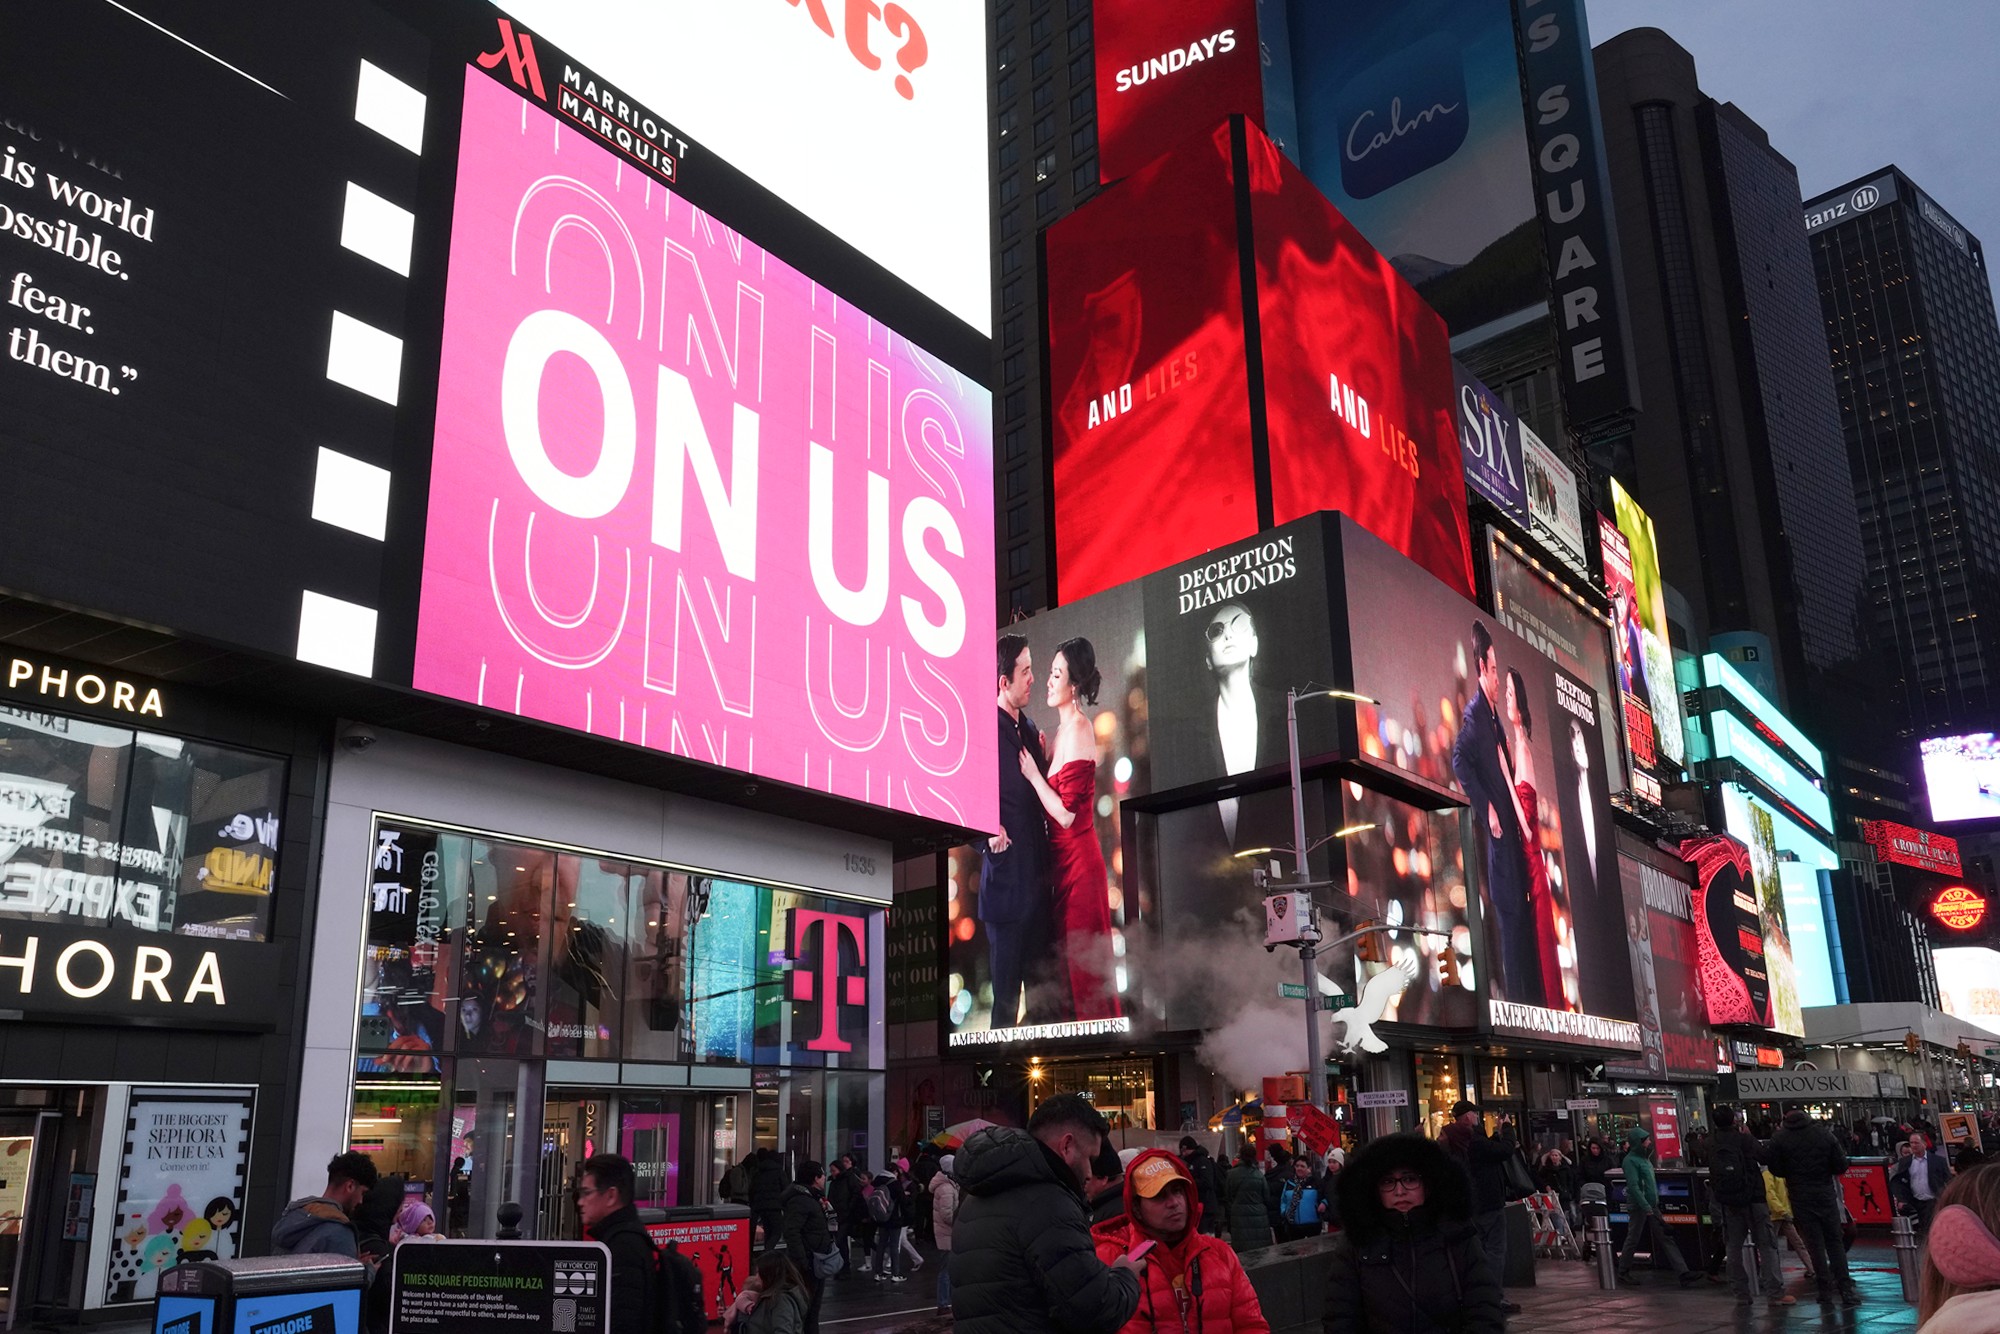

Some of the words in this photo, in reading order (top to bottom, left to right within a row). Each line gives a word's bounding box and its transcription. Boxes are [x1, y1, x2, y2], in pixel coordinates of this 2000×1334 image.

[1116, 29, 1236, 92] SUNDAYS
[563, 65, 689, 159] MARRIOTT
[561, 92, 675, 177] MARQUIS
[1346, 97, 1459, 162] Calm
[47, 173, 155, 243] world
[1923, 202, 1953, 238] Allianz
[1537, 84, 1606, 384] SQUARE
[8, 272, 95, 334] fear.
[1088, 382, 1132, 430] AND
[1145, 351, 1198, 402] LIES
[1329, 372, 1371, 439] AND
[1378, 413, 1420, 479] LIES
[1461, 385, 1520, 492] SIX
[502, 309, 760, 583] ON
[808, 440, 967, 658] US
[1178, 535, 1294, 593] DECEPTION
[1178, 557, 1297, 615] DIAMONDS
[8, 658, 164, 718] PHORA
[1554, 672, 1593, 710] DECEPTION
[1556, 689, 1596, 727] DIAMONDS
[843, 852, 876, 877] 1535
[1945, 891, 1969, 902] HOT
[1949, 915, 1975, 925] NOW
[1284, 984, 1307, 998] Broadway
[1325, 997, 1333, 1008] W
[1335, 997, 1346, 1007] 46
[952, 1029, 1009, 1047] AMERICAN
[1012, 1025, 1048, 1041] EAGLE
[1050, 1019, 1126, 1038] OUTFITTERS
[1496, 1002, 1554, 1033] AMERICAN
[1557, 1012, 1587, 1037] EAGLE
[1738, 1075, 1848, 1093] SWAROVSKI
[148, 1128, 226, 1143] SEPHORA
[152, 1114, 176, 1125] THE
[178, 1114, 228, 1126] BIGGEST
[586, 1103, 595, 1137] NYC
[147, 1146, 163, 1159] IN
[165, 1146, 194, 1159] THE
[197, 1146, 224, 1159] USA
[160, 1163, 184, 1172] Come
[654, 1228, 672, 1236] MOST
[673, 1227, 688, 1236] TONY
[689, 1224, 738, 1236] AWARD-WINNING
[403, 1273, 427, 1285] TIMES
[428, 1274, 461, 1286] SQUARE
[462, 1275, 514, 1288] PEDESTRIAN
[515, 1276, 543, 1289] PLAZA
[441, 1292, 469, 1300] Crossroads
[554, 1271, 596, 1295] DOT
[409, 1308, 434, 1316] courteous
[444, 1309, 471, 1318] respectful
[477, 1311, 496, 1319] others,
[508, 1312, 525, 1321] please
[526, 1313, 540, 1321] keep
[410, 1316, 423, 1324] plaza
[480, 1302, 504, 1311] enjoyable
[505, 1303, 519, 1311] time.
